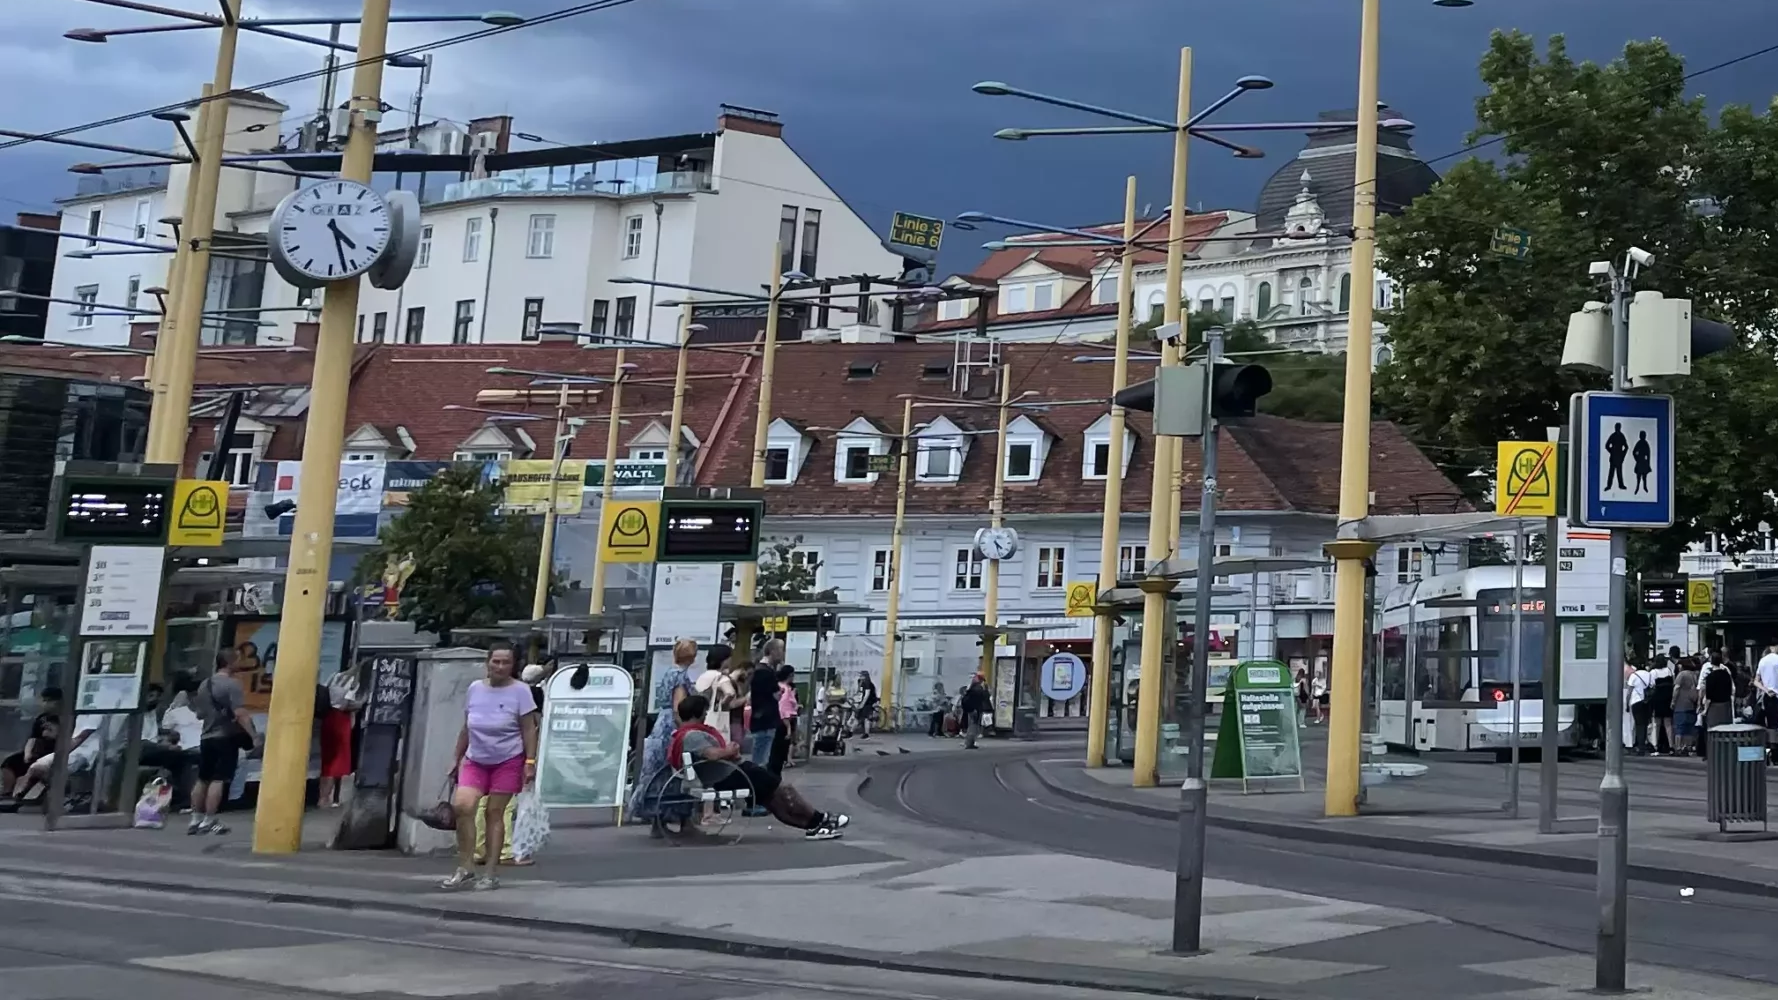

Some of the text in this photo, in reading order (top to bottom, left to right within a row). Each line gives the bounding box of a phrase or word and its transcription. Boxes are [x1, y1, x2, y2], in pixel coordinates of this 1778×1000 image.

[312, 205, 363, 216] GRAZ
[895, 214, 942, 235] Linie 3
[891, 229, 939, 248] Linie 6
[1493, 229, 1521, 244] Linie
[553, 705, 613, 716] Information
